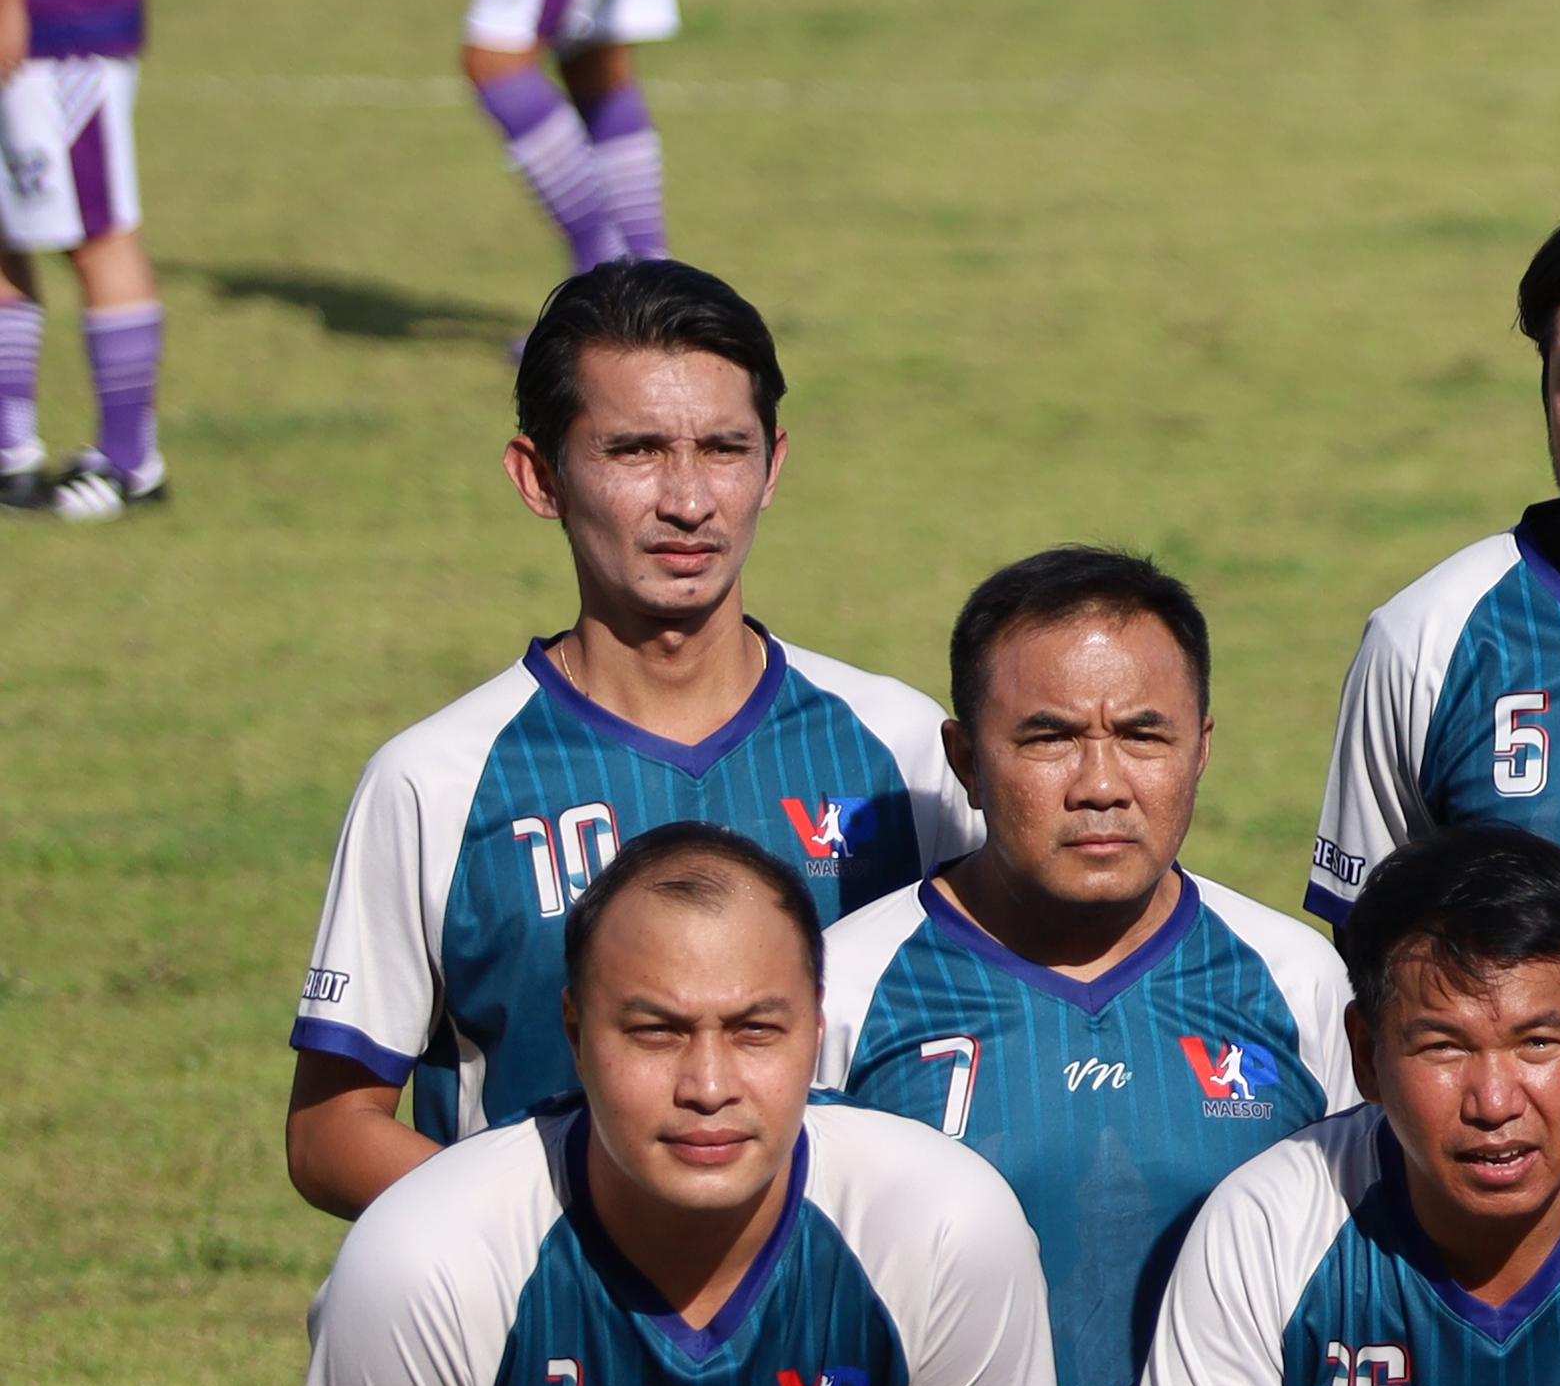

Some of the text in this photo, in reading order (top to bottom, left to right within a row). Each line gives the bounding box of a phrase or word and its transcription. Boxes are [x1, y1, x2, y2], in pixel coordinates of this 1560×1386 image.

[1493, 691, 1550, 797] 5
[511, 801, 620, 917] 10
[920, 1035, 980, 1139] 7
[1203, 1100, 1273, 1120] MAESOT
